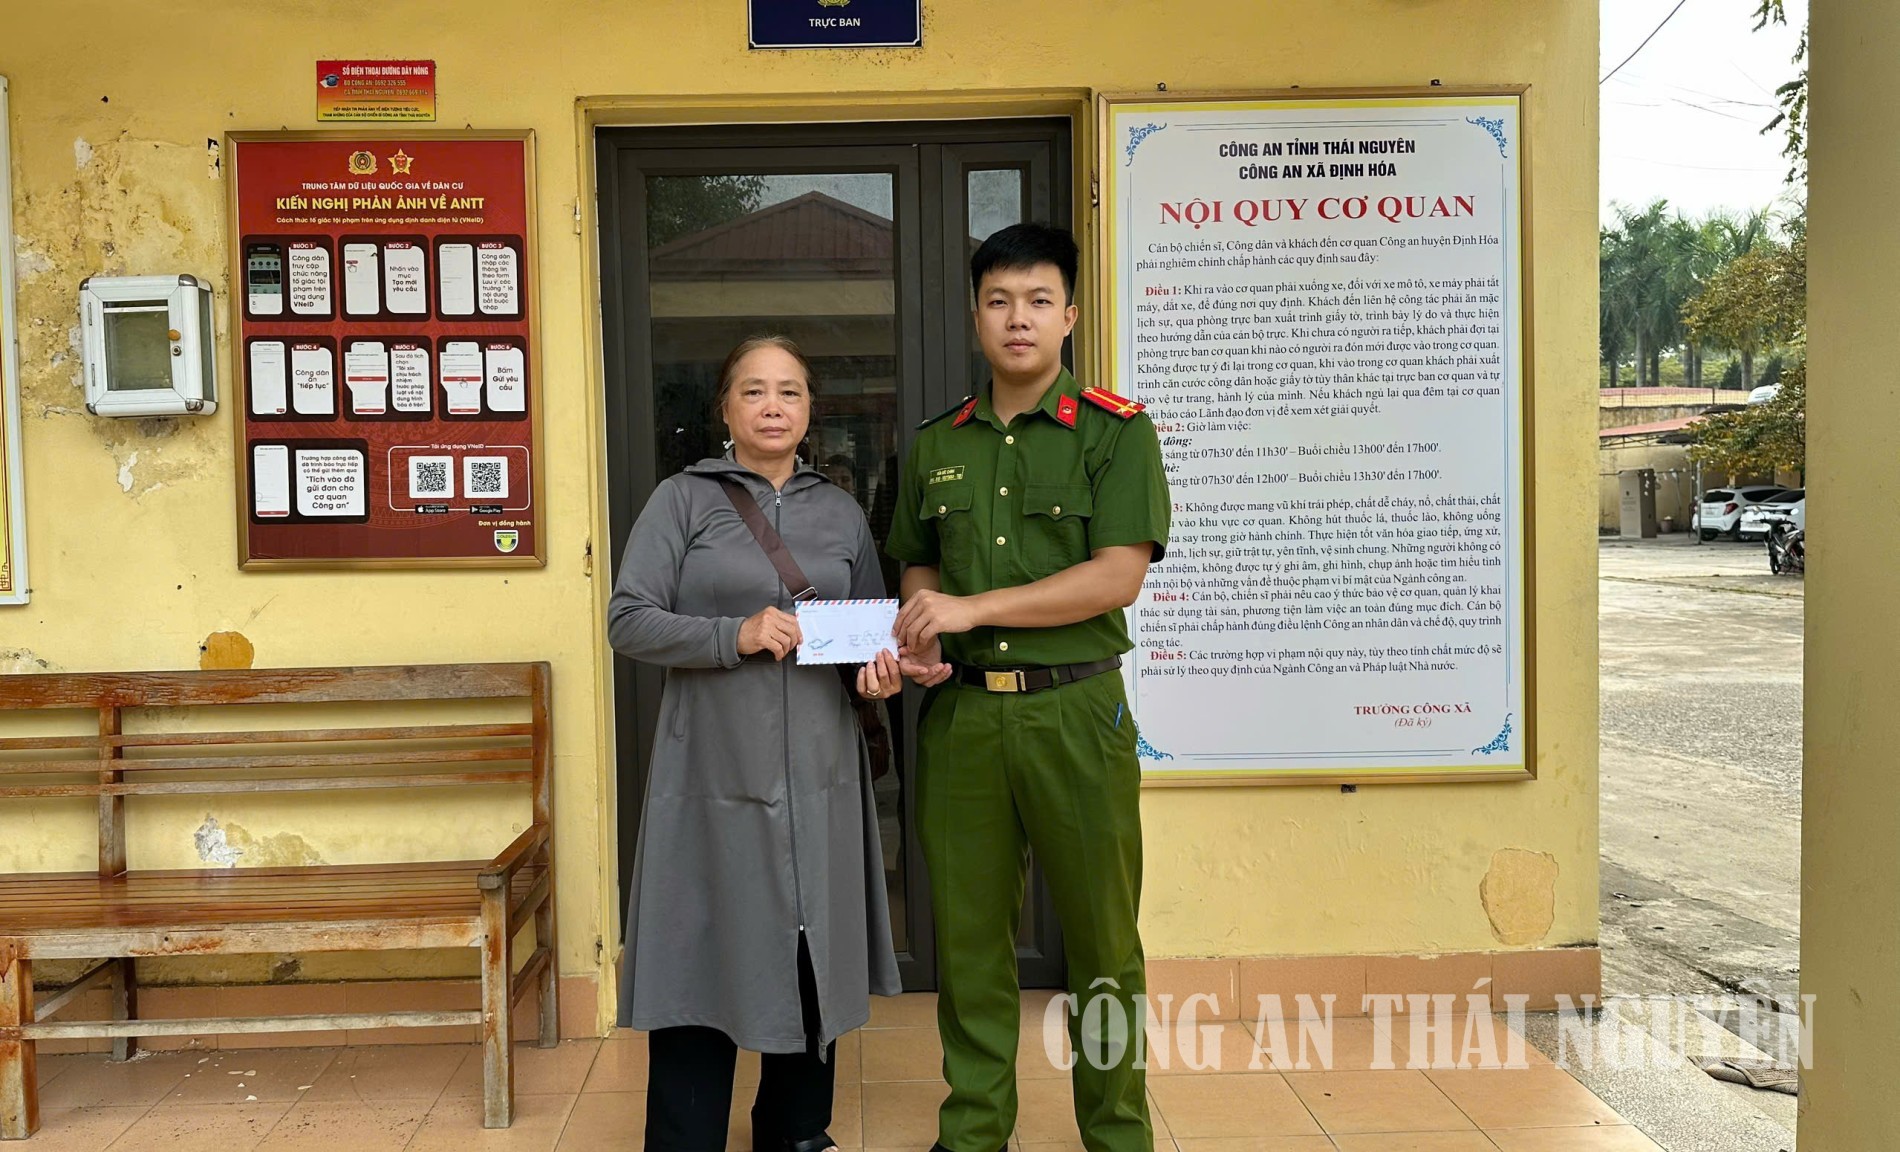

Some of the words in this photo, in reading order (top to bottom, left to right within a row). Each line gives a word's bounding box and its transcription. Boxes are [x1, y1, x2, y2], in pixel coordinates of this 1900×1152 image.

[809, 18, 837, 28] TRỰC
[839, 18, 860, 27] BAN
[1219, 141, 1257, 157] CÔNG
[1262, 142, 1282, 156] AN
[1286, 138, 1318, 155] TỈNH
[1322, 138, 1354, 154] THÁI
[1359, 137, 1414, 154] NGUYÊN
[1239, 163, 1277, 179] CÔNG
[1282, 165, 1302, 178] AN
[1306, 161, 1325, 177] XÃ
[1329, 163, 1363, 180] ĐỊNH
[1368, 160, 1396, 176] HÓA
[361, 182, 376, 190] LIỆU
[378, 181, 402, 189] QUỐC
[421, 180, 430, 189] VỀ
[277, 194, 307, 209] KIẾN
[312, 198, 348, 211] NGHỊ
[353, 194, 391, 209] PHẢN
[429, 193, 446, 209] VỀ
[450, 197, 484, 209] ANTT
[1160, 198, 1222, 229] NỘI
[1234, 198, 1308, 226] QUY
[1317, 195, 1368, 219] CƠ
[1378, 195, 1474, 223] QUAN
[1148, 243, 1168, 253] Cán
[1170, 242, 1182, 253] bộ
[1184, 241, 1211, 251] chiến
[1213, 241, 1224, 252] sĩ,
[1226, 240, 1253, 252] Công
[1255, 239, 1273, 249] dân
[1275, 239, 1286, 248] và
[1289, 238, 1318, 248] khách
[1320, 237, 1337, 247] đến
[1354, 239, 1377, 249] quan
[1379, 236, 1406, 248] Công
[1421, 235, 1450, 247] huyện
[1453, 235, 1477, 246] Định
[1479, 235, 1498, 244] Hóa
[1145, 283, 1169, 296] Điều
[1172, 286, 1181, 295] 1:
[1184, 284, 1202, 295] Khi
[1217, 283, 1233, 293] vào
[1236, 285, 1248, 293] cơ
[1250, 285, 1273, 295] quan
[1276, 281, 1296, 294] phải
[1298, 280, 1329, 292] xuống
[1332, 283, 1345, 291] xe,
[1348, 278, 1363, 289] đối
[1366, 279, 1381, 289] với
[1397, 278, 1412, 288] mô
[1415, 278, 1426, 289] tô,
[1442, 278, 1462, 290] máy
[1465, 277, 1486, 289] phải
[1488, 278, 1499, 287] tắt
[295, 369, 314, 377] Công
[1175, 422, 1185, 432] 2:
[1187, 421, 1206, 431] Giờ
[1208, 421, 1226, 431] làm
[1228, 420, 1252, 432] việc:
[1166, 449, 1188, 461] sáng
[1190, 449, 1199, 458] từ
[1236, 447, 1253, 457] đến
[1298, 445, 1322, 455] Buổi
[1324, 442, 1350, 455] chiều
[1387, 441, 1404, 453] đến
[307, 485, 319, 493] gửi
[1354, 703, 1409, 714] TRƯỞNG
[1413, 702, 1450, 713] CÔNG
[1454, 702, 1471, 712] XÃ
[1395, 718, 1413, 727] (Đã
[1417, 717, 1431, 728] ký)
